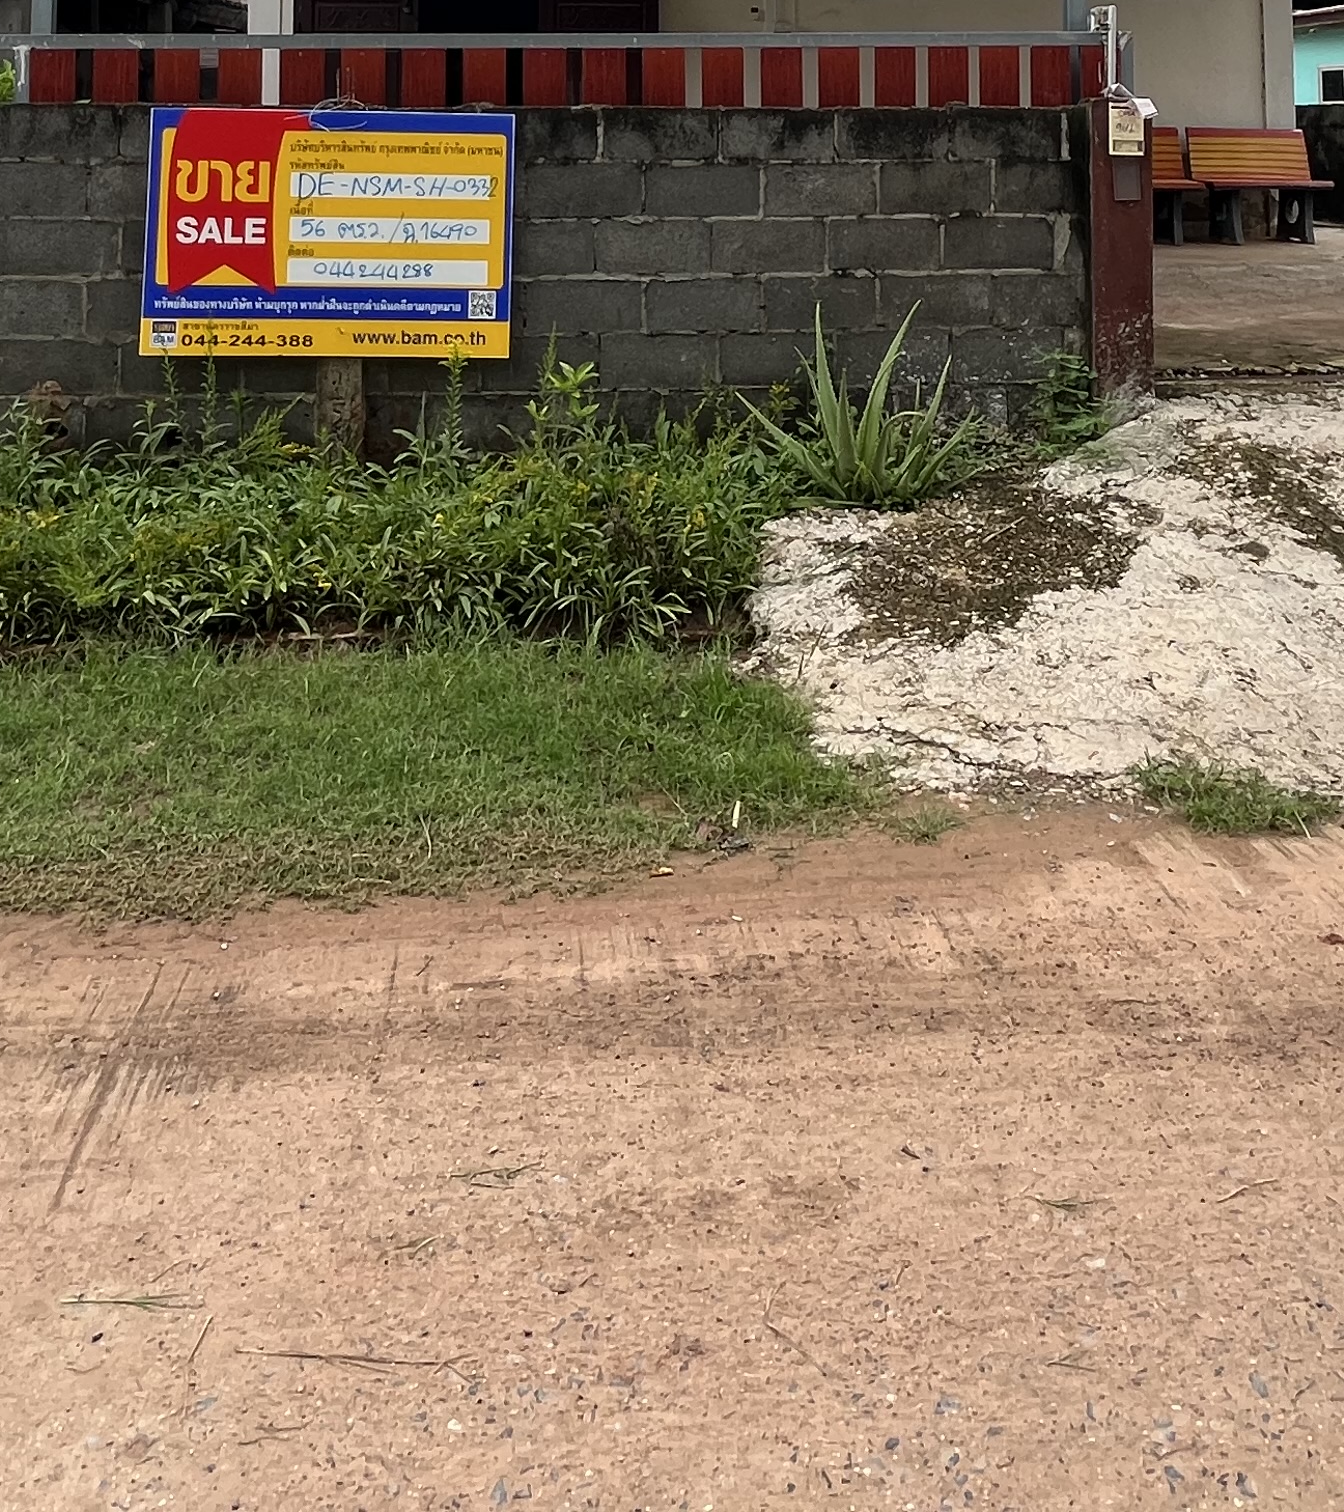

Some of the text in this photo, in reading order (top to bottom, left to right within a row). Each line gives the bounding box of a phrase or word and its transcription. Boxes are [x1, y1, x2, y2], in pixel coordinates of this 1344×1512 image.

[176, 159, 271, 203] ขาย
[175, 216, 267, 245] SALE
[301, 219, 326, 237] 56
[313, 261, 434, 280] 044244288
[181, 334, 314, 347] 044-244-388
[352, 330, 486, 346] www.bam.co.th
